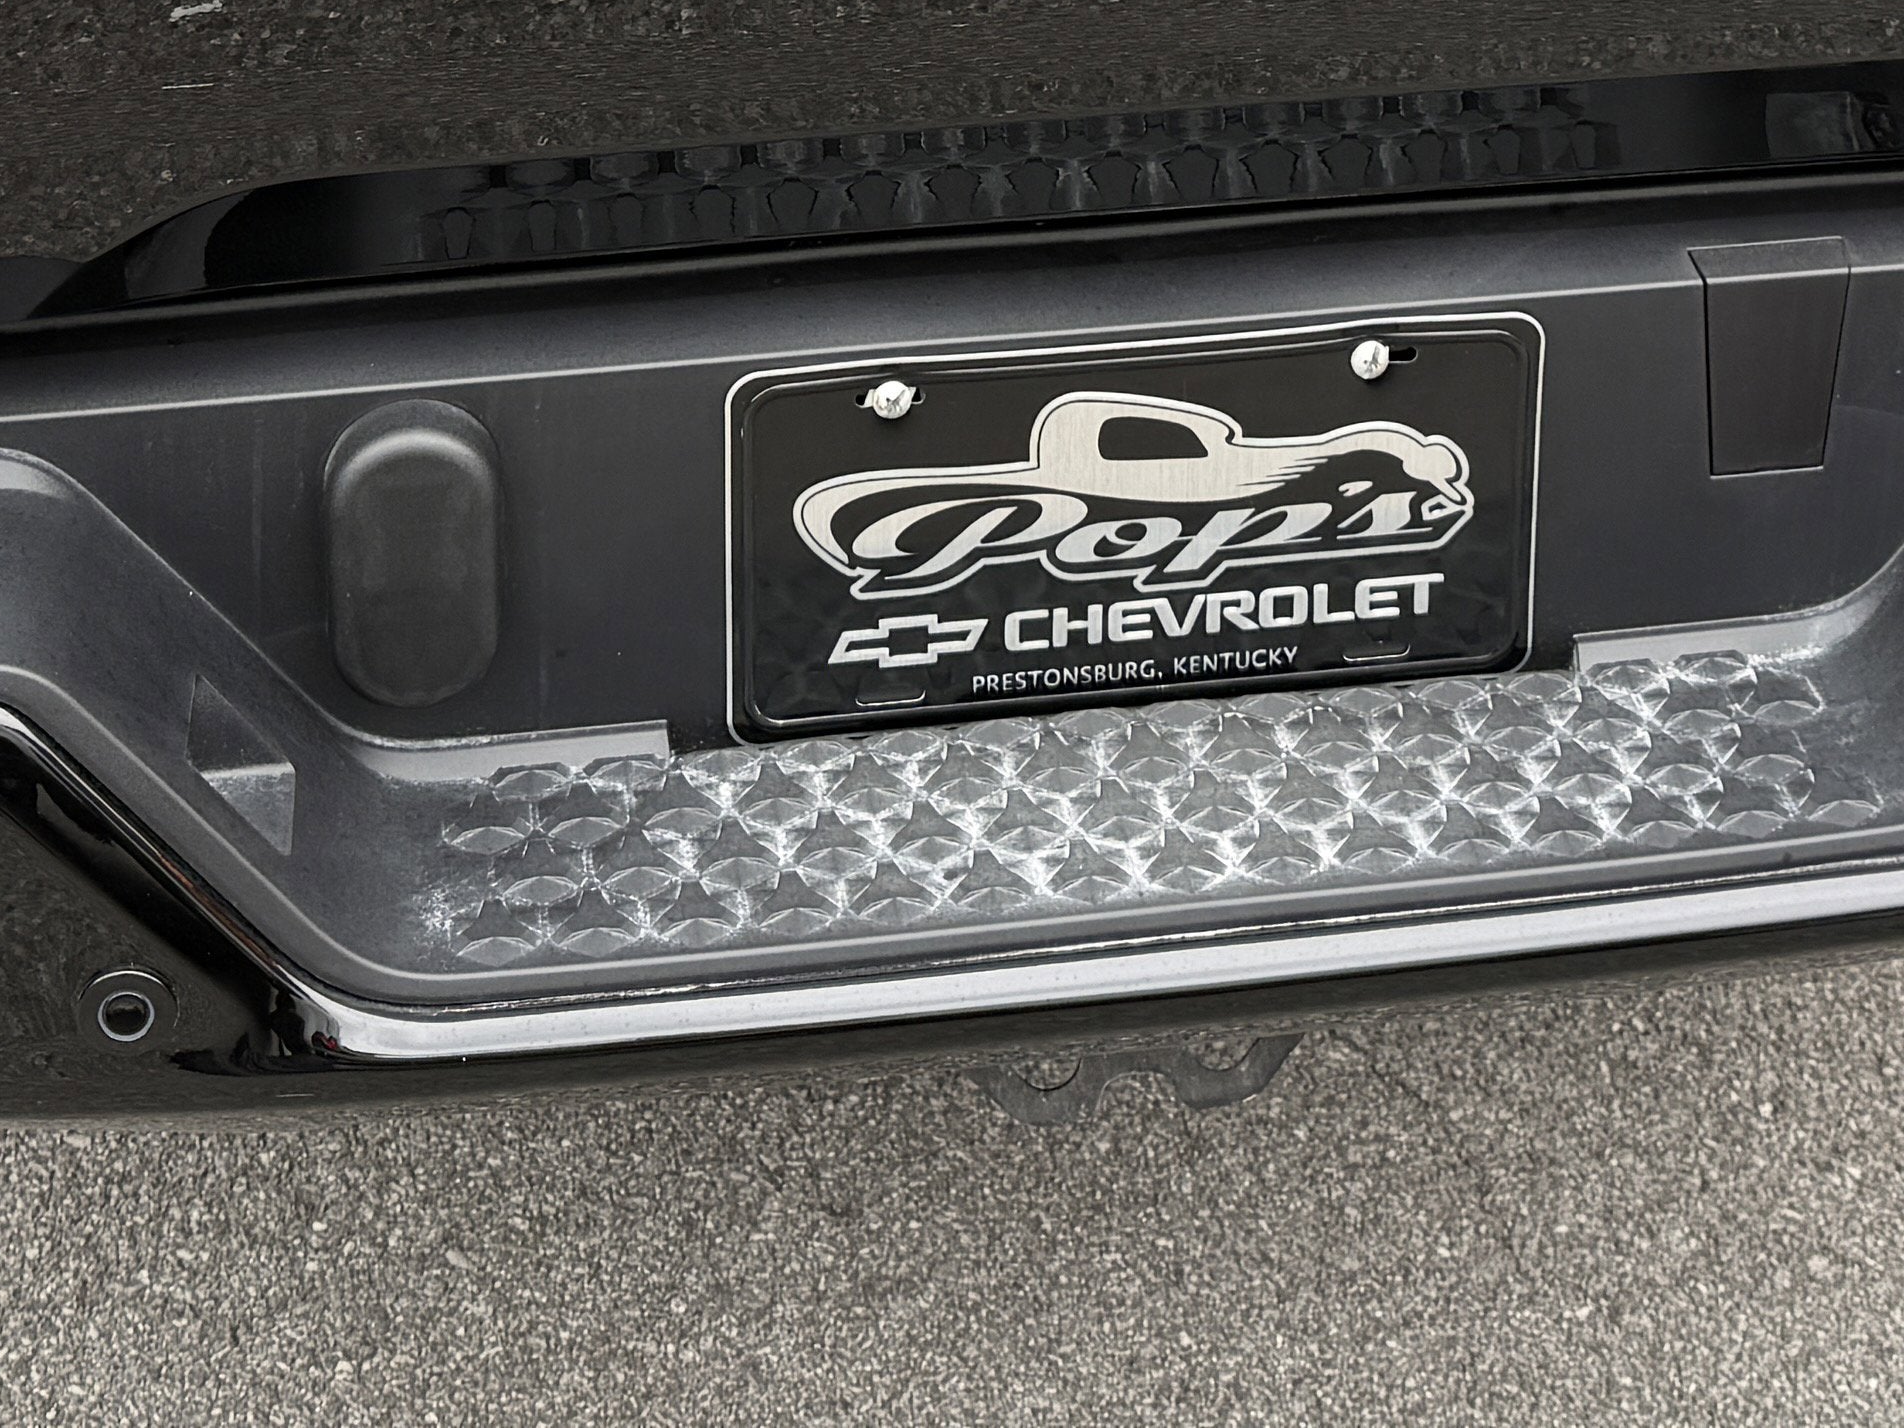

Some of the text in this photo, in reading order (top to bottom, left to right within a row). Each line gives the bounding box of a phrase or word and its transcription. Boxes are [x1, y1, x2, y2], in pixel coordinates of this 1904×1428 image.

[852, 479, 1434, 581] Pop's
[1004, 573, 1444, 652] CHEVROLET
[971, 646, 1299, 693] PRESTONSBURG, KENTUCKY
